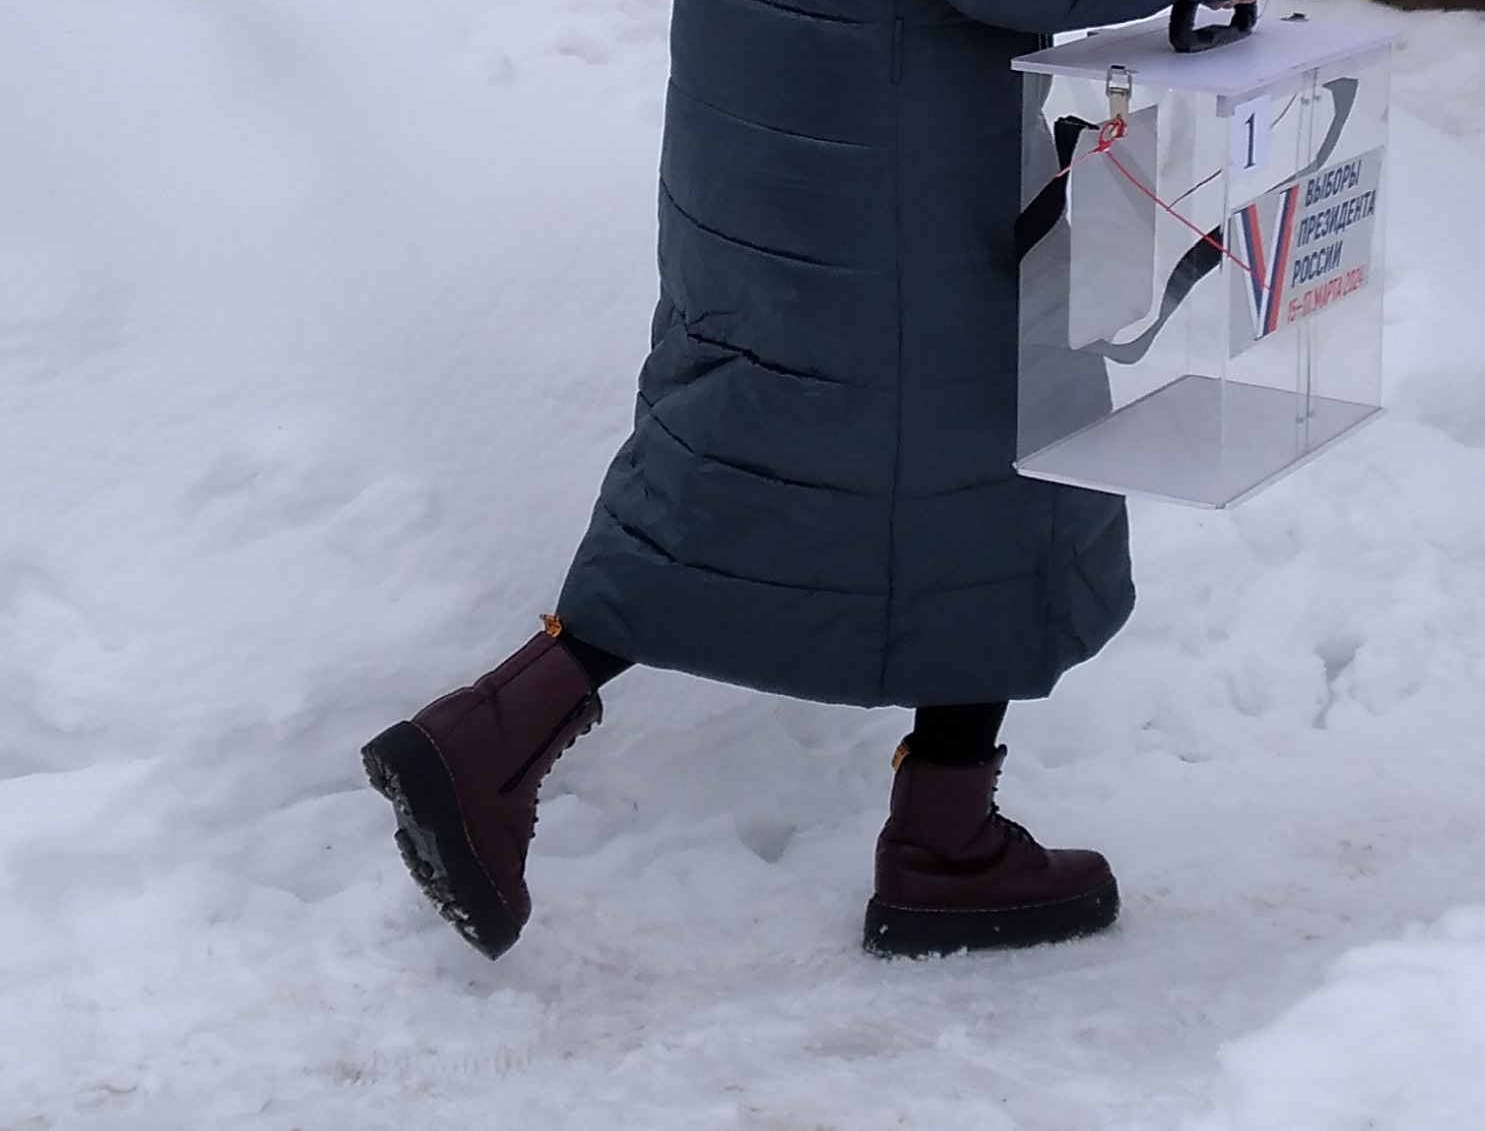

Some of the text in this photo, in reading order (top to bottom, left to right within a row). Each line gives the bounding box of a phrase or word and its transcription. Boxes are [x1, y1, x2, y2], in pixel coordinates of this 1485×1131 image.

[1243, 111, 1257, 170] 1
[1304, 159, 1362, 208] ВЫБОРЫ
[1297, 188, 1376, 248] ПРЕЗИДЕНТА
[1291, 240, 1343, 289] РОССИИ
